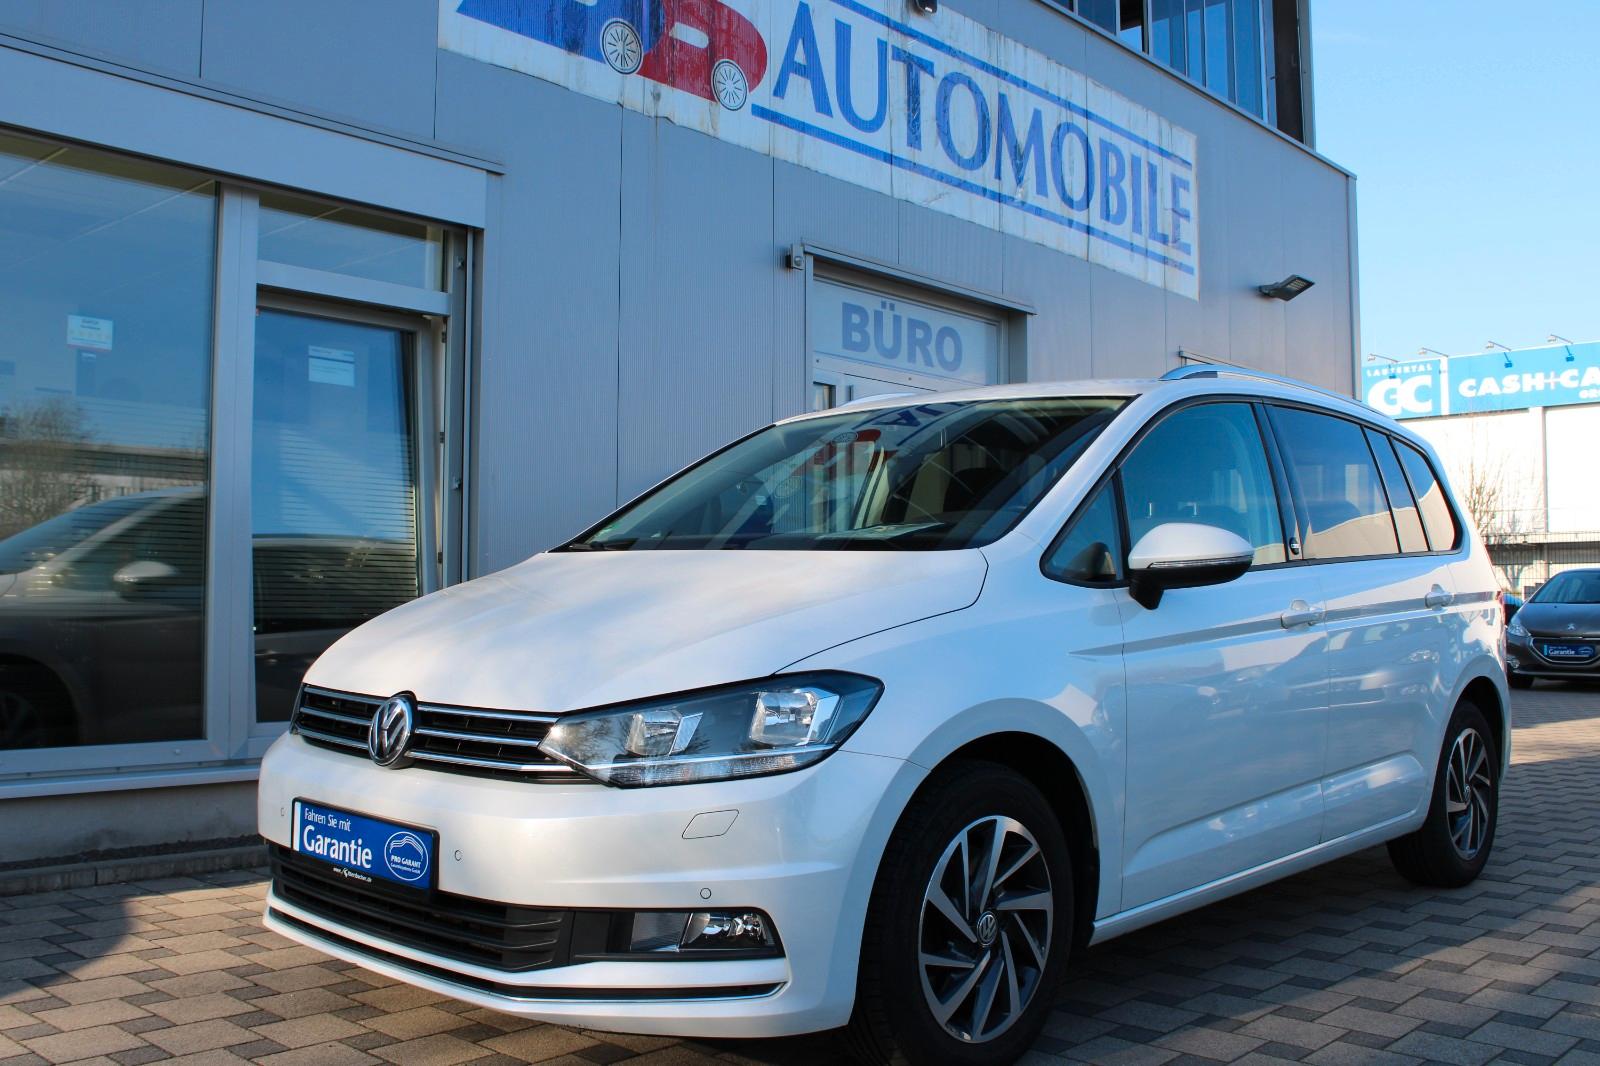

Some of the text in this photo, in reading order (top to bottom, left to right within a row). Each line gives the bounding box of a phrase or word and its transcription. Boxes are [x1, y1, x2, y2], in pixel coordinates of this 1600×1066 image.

[773, 0, 1191, 256] AUTOMOBILE
[841, 301, 963, 372] BÜRO
[1368, 375, 1433, 416] GC
[304, 807, 352, 832] Fahren Sie mit
[303, 824, 373, 869] Garantie
[391, 854, 401, 863] PRO
[402, 857, 421, 869] GARANT
